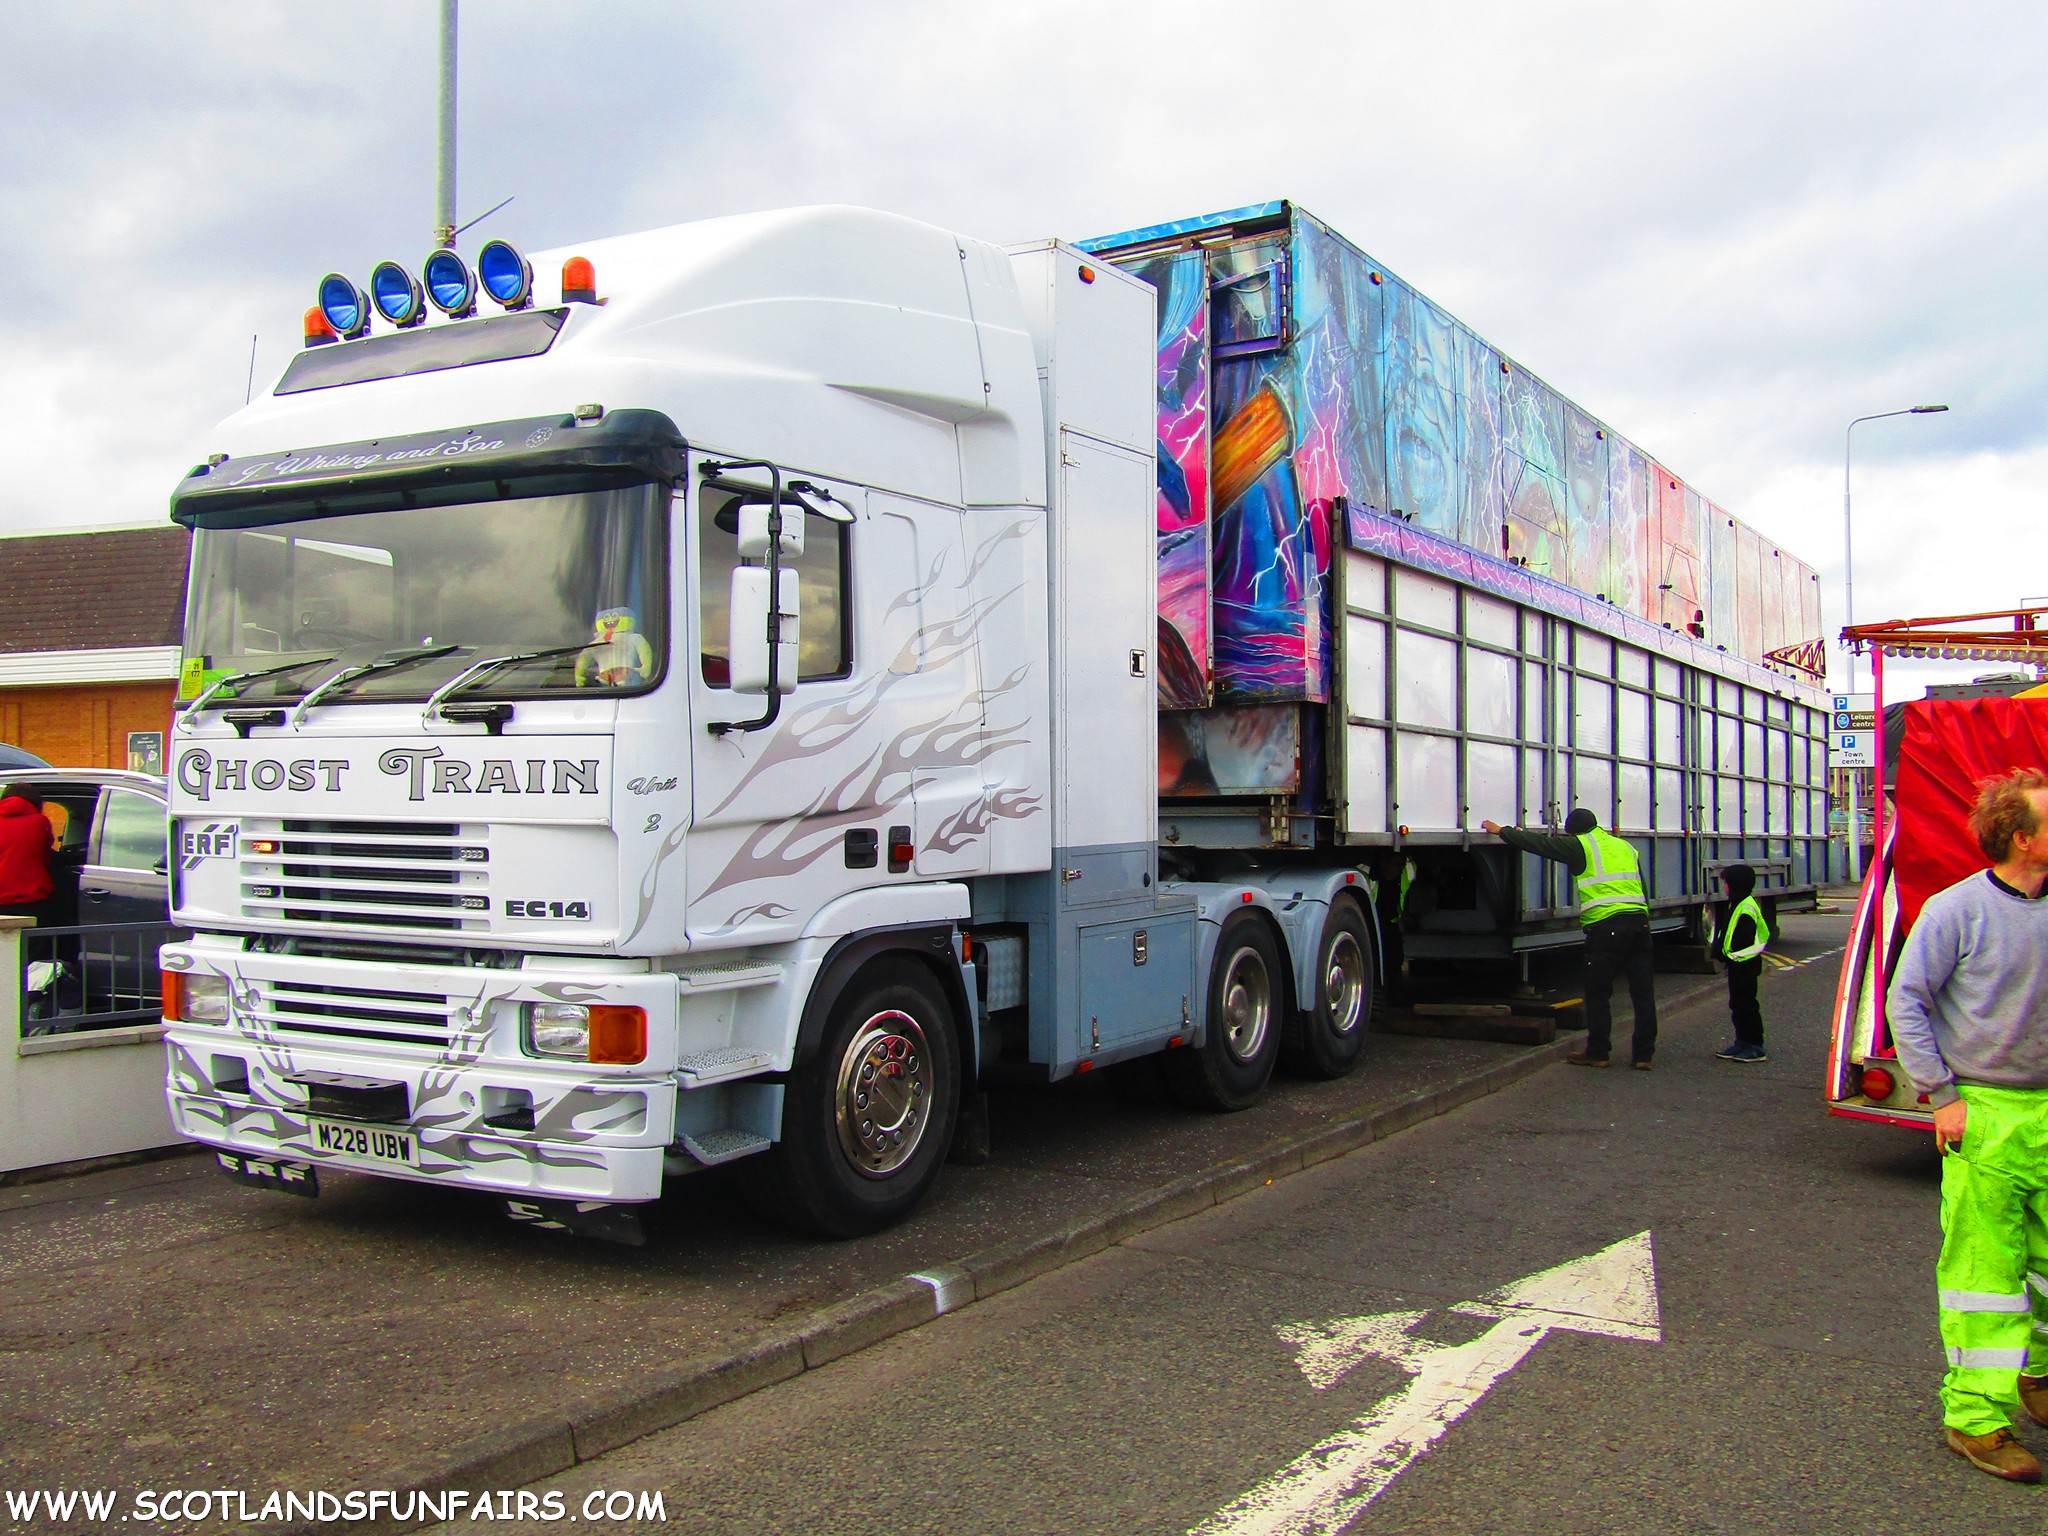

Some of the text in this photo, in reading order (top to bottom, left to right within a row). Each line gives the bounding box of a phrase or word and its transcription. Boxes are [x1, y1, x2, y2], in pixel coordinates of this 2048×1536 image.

[275, 452, 382, 476] Whiting
[386, 441, 447, 462] and
[443, 435, 505, 456] Son
[178, 745, 600, 802] GHOST TRAIN
[626, 776, 678, 795] Unit
[643, 813, 662, 834] 2
[182, 831, 232, 857] ERF
[505, 899, 589, 920] EC14
[318, 1123, 410, 1161] M228 UBW
[217, 1152, 306, 1182] ERF
